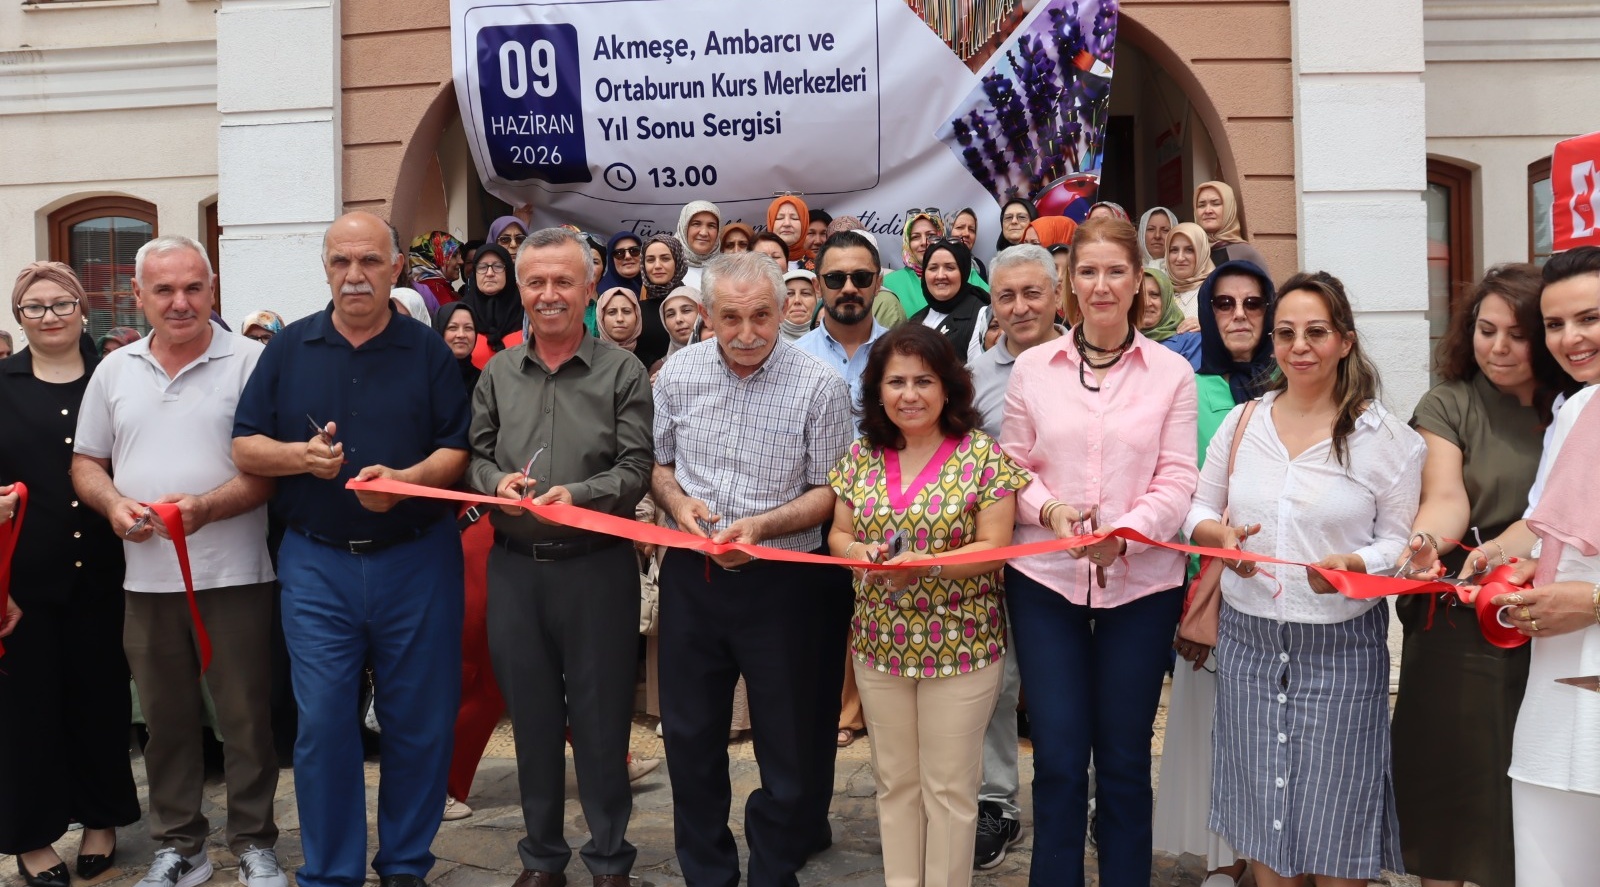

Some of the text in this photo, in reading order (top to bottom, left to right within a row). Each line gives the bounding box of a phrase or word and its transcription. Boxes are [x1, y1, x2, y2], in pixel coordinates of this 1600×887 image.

[593, 28, 835, 65] Akmeşe, Ambarcı ve
[499, 39, 558, 99] 09
[595, 66, 867, 103] Ortaburun Kurs Merkezleri
[491, 111, 574, 136] HAZİRAN
[598, 110, 782, 142] Yıl Sonu Sergisi
[510, 145, 562, 165] 2026
[648, 164, 718, 189] 13.00
